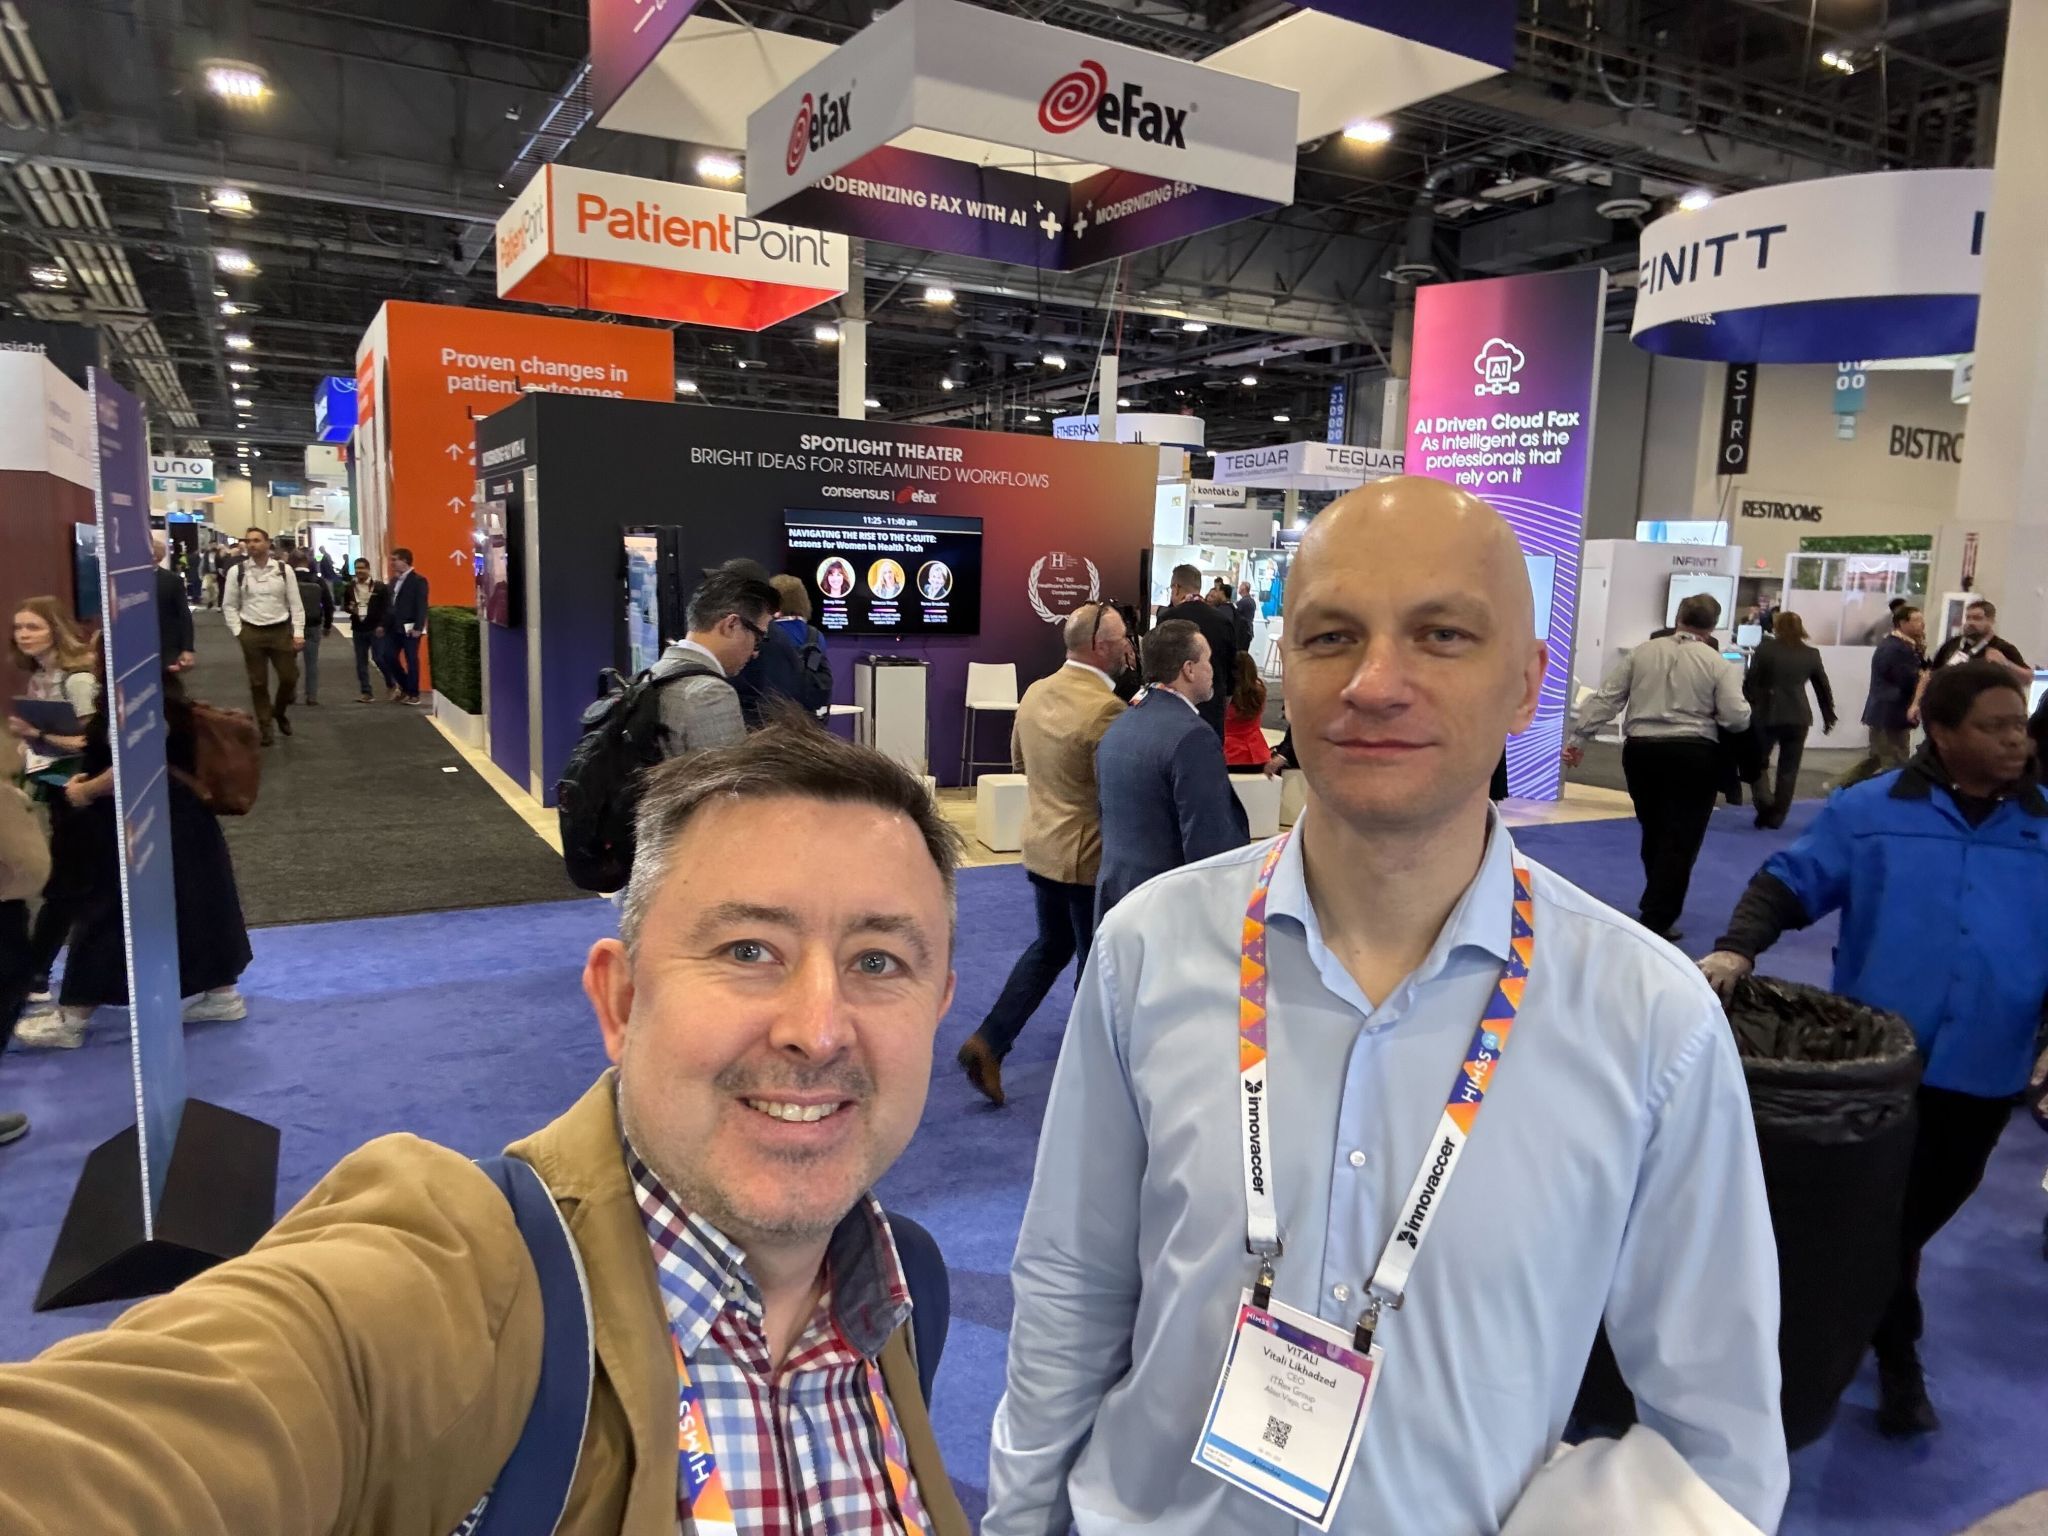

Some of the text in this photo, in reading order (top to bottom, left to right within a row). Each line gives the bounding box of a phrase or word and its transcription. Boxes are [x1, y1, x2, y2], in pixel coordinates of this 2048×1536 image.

[808, 91, 851, 152] eFax
[1097, 82, 1188, 149] eFax
[930, 192, 962, 216] FAX
[966, 199, 1006, 222] WITH
[1010, 210, 1027, 227] AI
[1096, 184, 1171, 225] MODERNIZING
[577, 192, 830, 267] PatientPoint
[441, 348, 628, 382] Proven changes in
[1491, 363, 1506, 377] AI
[447, 374, 520, 394] patient
[1414, 411, 1580, 434] AI Driven Cloud Fax
[800, 434, 963, 462] SPOTLIGHT THEATER
[1421, 430, 1570, 452] As intelligent as the
[691, 447, 1050, 488] BRIGHT IDEAS FOR STREAMLINED WORKFLOWS
[1225, 450, 1289, 471] TEGUAR
[1326, 448, 1405, 470] TEGUAR
[1426, 448, 1562, 471] professionals that
[1456, 467, 1522, 487] rely on it
[822, 486, 937, 504] consensus eFax
[1198, 486, 1239, 497] kontakt.io
[863, 516, 882, 525] 11:25
[887, 517, 905, 526] 11:40
[1742, 501, 1823, 522] RESTROOMS
[789, 528, 937, 543] NAVIGATING THE RISE TO THE C-SUITE:
[789, 539, 924, 552] Lessons for Women in Health Tech
[1052, 553, 1064, 568] H
[1672, 555, 1719, 568] INFINITT
[1461, 1049, 1492, 1103] HIMSS
[1247, 1096, 1265, 1196] innovaccer
[1405, 1136, 1456, 1233] innovaccer
[1287, 1344, 1319, 1366] VITALI
[1263, 1346, 1337, 1388] Vitali Likhadzed
[1286, 1372, 1305, 1386] CEO
[679, 1401, 710, 1485] HIMSS
